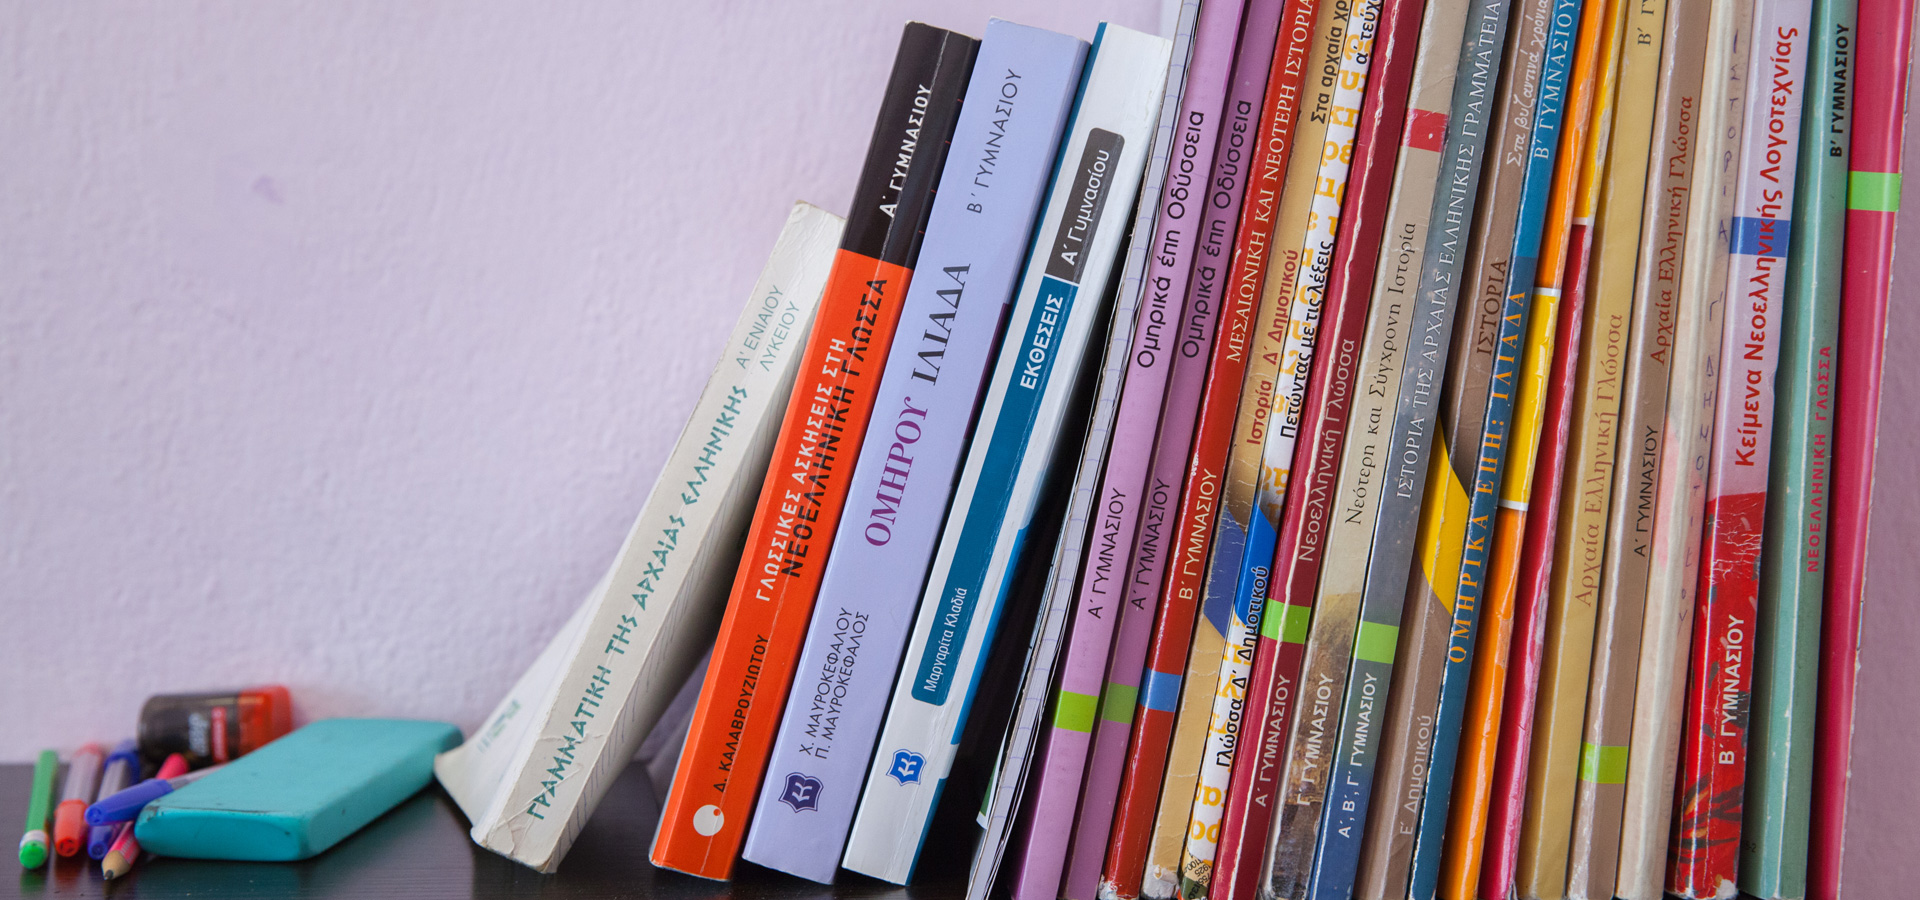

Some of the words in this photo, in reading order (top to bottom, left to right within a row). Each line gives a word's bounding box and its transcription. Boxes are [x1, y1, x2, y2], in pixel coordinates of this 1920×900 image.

[1284, 0, 1315, 77] ΙΣΤΟΡΙΑ
[1320, 26, 1343, 87] αρχαία
[1538, 0, 1575, 131] ΓΥΜΝΑΣΙΟΥ
[1830, 23, 1850, 135] ΓΥΜΝΑΣΙΟΥ
[889, 84, 932, 191] ΓΥΜΝΑΣΙΟΥ
[974, 68, 1022, 189] ΓΥΜΝΑΣΙΟΥ
[1263, 82, 1297, 183] ΝΕΟΤΕΡΗ
[1310, 92, 1331, 125] Στα
[1512, 49, 1540, 130] βυζαντινά
[1668, 95, 1693, 179] Γλώσσα
[1760, 26, 1798, 184] Λογοτεχνίας
[1066, 149, 1110, 243] Γυμνασίου
[1166, 110, 1205, 220] Οδύσσεια
[1212, 99, 1252, 210] Οδύσσεια
[1506, 133, 1526, 168] Στα
[1159, 229, 1181, 268] έπη
[1205, 218, 1227, 258] έπη
[1254, 190, 1275, 224] ΚΑΙ
[1438, 143, 1475, 266] ΕΛΛΗΝΙΚΗΣ
[1658, 185, 1688, 284] Ελληνική
[1226, 230, 1267, 364] ΜΕΣΑΙΩΝΙΚΗ
[1306, 240, 1334, 296] λέξεις
[1387, 222, 1417, 296] Ιστορία
[1476, 259, 1507, 356] ΙΣΤΟΡΙΑ
[1743, 188, 1784, 362] Νεοελληνικής
[743, 285, 783, 351] ΕΝΙΑΙΟΥ
[759, 301, 800, 372] ΛΥΚΕΙΟΥ
[1019, 293, 1064, 390] ΕΚΘΕΣΕΙΣ
[1136, 275, 1172, 369] Ομηρικά
[1181, 265, 1217, 358] Ομηρικά
[1246, 380, 1274, 445] Ιστορία
[1267, 248, 1299, 344] Δημοτικού
[1300, 324, 1315, 350] με
[1305, 297, 1321, 323] τις
[1369, 303, 1401, 398] Σύγχρονη
[1422, 270, 1451, 363] ΑΡΧΑΙΑΣ
[1596, 314, 1624, 403] Γλώσσα
[1650, 289, 1673, 366] Αρχαία
[781, 385, 856, 578] ΝΕΟΕΛΛΗΝΙΚΗ
[840, 278, 889, 377] ΓΛΩΣΣΑ
[865, 396, 929, 547] ΟΜΗΡΟΥ
[911, 263, 971, 386] ΙΛΙΑΔΑ
[1280, 352, 1312, 439] Πετώντας
[1367, 405, 1383, 435] και
[1412, 367, 1434, 408] ΤΗΣ
[1735, 369, 1763, 467] Κείμενα
[1814, 345, 1832, 421] ΓΛΩΣΣΑ
[756, 489, 802, 602] ΓΛΩΣΣΙΚΕΣ
[791, 383, 833, 485] ΑΣΚΗΣΕΙΣ
[822, 338, 847, 378] ΣΤΗ
[1298, 428, 1342, 562] Νεοελληνική
[1324, 338, 1356, 423] Γλώσσα
[1344, 444, 1376, 525] Νεότερη
[1396, 417, 1425, 500] ΙΣΤΟΡΙΑ
[1448, 514, 1489, 664] ΟΜΗΡΙΚΑ
[1491, 291, 1526, 401] ΙΛΙΑΔΑ
[1583, 410, 1618, 515] Ελληνική
[1635, 425, 1659, 533] ΓΥΜΝΑΣΙΟΥ
[1091, 486, 1127, 594] ΓΥΜΝΑΣΙΟΥ
[1135, 477, 1171, 586] ΓΥΜΝΑΣΙΟΥ
[1182, 467, 1218, 578] ΓΥΜΝΑΣΙΟΥ
[1807, 433, 1827, 573] ΝΕΟΕΛΛΗΝΙΚΗ
[1574, 523, 1600, 608] Αρχαία
[806, 607, 853, 738] ΜΑΥΡΟΚΕΦΑΛΟΥ
[820, 611, 870, 741] ΜΑΥΡΟΚΕΦΑΛΟΣ
[923, 629, 955, 692] Μαργαρίτα
[943, 587, 968, 629] Κλαδιά
[1215, 697, 1244, 768] Γλώσσα
[1237, 565, 1269, 661] Δημοτικού
[1721, 614, 1745, 738] ΓΥΜΝΑΣΙΟΥ
[527, 665, 611, 820] ΓΡΑΜΜΑΤΙΚΗ
[605, 614, 637, 655] ΤΗΣ
[718, 634, 770, 773] ΚΑΛΑΒΡΟΥΖΙΩΤΟΥ
[814, 744, 831, 760] Π.
[1259, 674, 1291, 782] ΓΥΜΝΑΣΙΟΥ
[1301, 673, 1335, 784] ΓΥΜΝΑΣΙΟΥ
[1350, 672, 1378, 767] ΓΥΜΝΑΣΙΟΥ
[713, 777, 728, 793] Δ.
[1403, 714, 1432, 813] Δημοτικού
